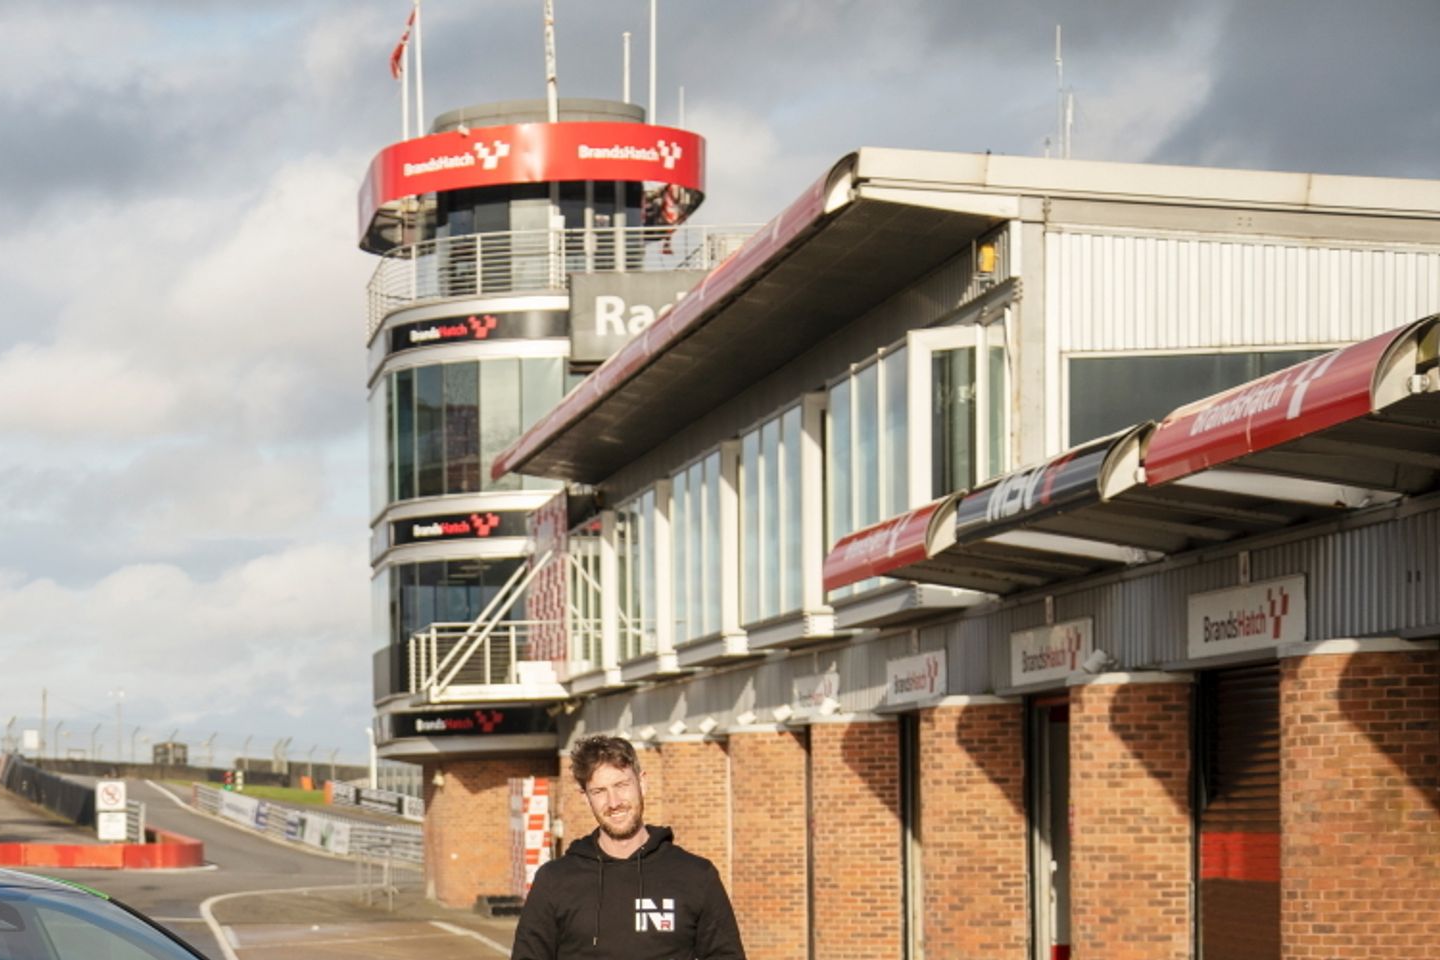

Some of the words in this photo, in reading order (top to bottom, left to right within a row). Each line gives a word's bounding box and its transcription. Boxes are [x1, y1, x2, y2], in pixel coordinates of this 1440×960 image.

[578, 145, 659, 162] BrandsHatch
[410, 323, 468, 342] BrandsHatch
[1204, 605, 1266, 643] BrandsHatch
